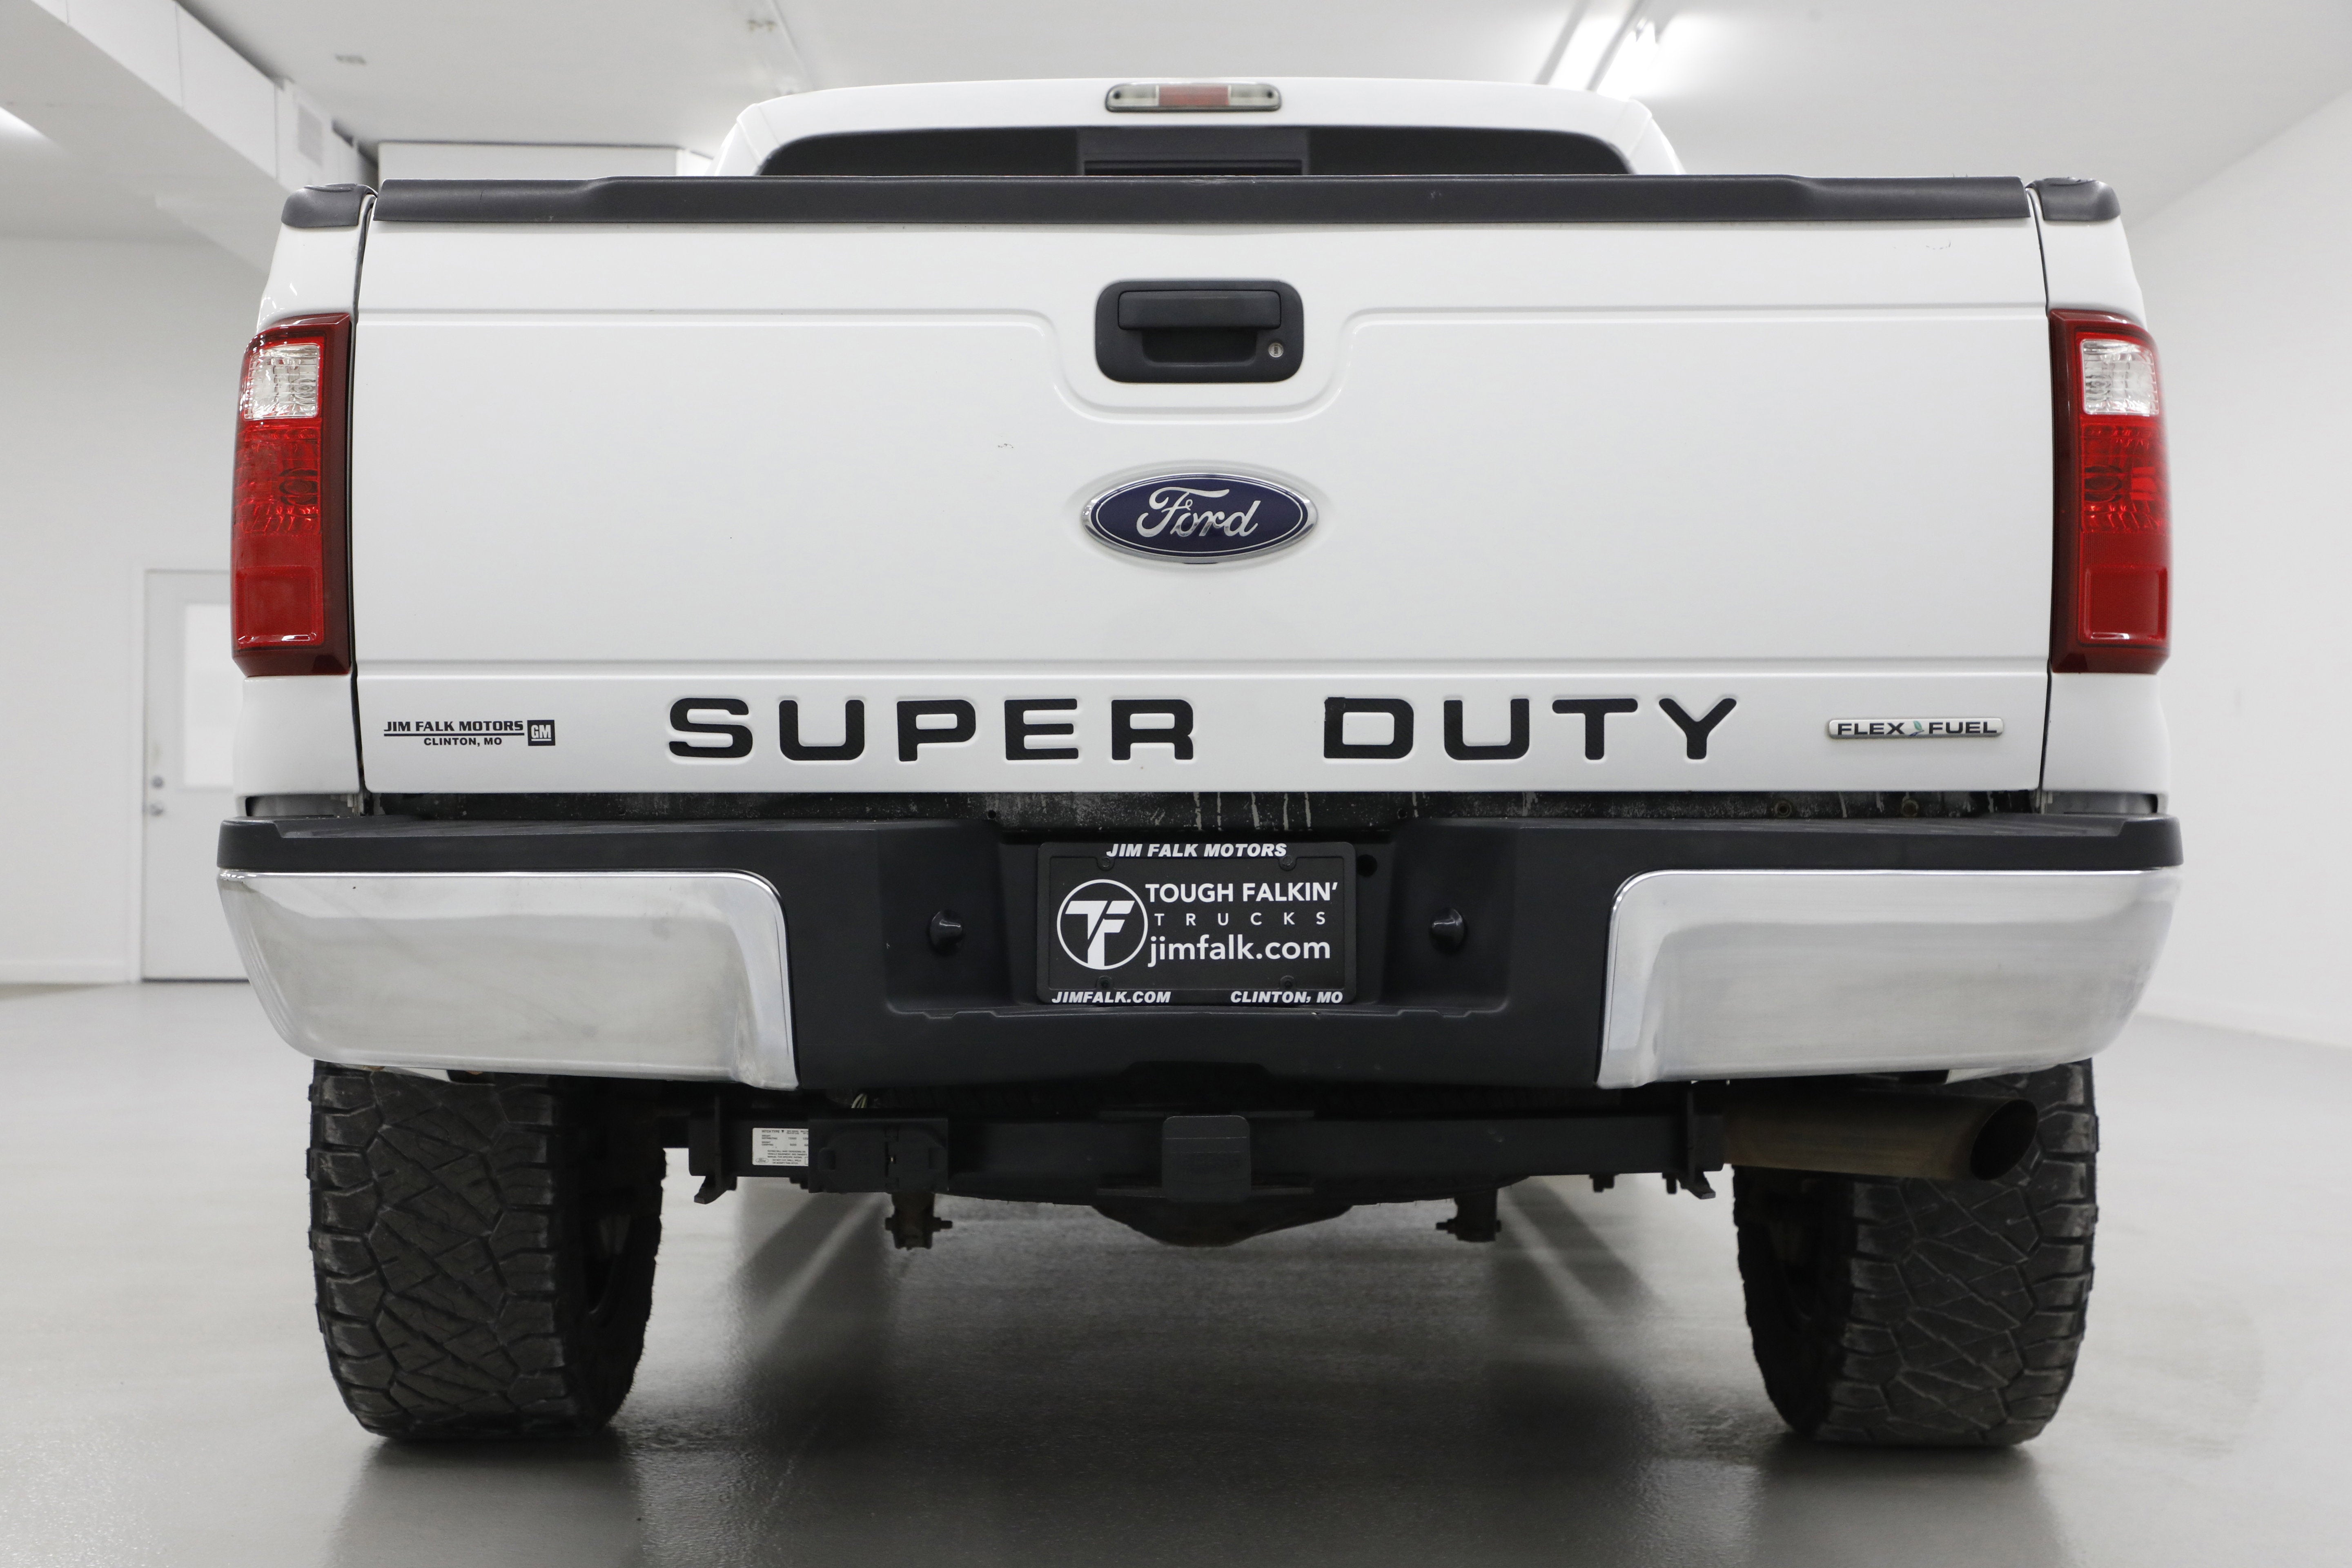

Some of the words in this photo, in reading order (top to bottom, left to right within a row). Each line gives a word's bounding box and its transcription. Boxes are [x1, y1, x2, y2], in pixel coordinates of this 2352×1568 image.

[1136, 487, 1261, 537] Ford
[384, 721, 410, 731] JIM
[416, 721, 454, 731] FALK
[459, 721, 523, 731] MOTORS
[531, 724, 551, 738] GM
[669, 698, 1193, 761] SUPER
[1324, 697, 1736, 760] DUTY
[1838, 723, 1904, 735] FLEX
[1929, 722, 1997, 734] FUEL
[424, 737, 480, 746] CLINTON,
[1107, 844, 1143, 857] JIM
[1147, 844, 1198, 857] FALK
[1204, 843, 1287, 857] MOTORS
[1145, 883, 1233, 902] TOUGH
[1148, 934, 1330, 967] jimfalk.com
[1052, 991, 1171, 1003] JIMFALK.COM
[1231, 991, 1311, 1003] CLINTON,
[1316, 991, 1343, 1003] MO
